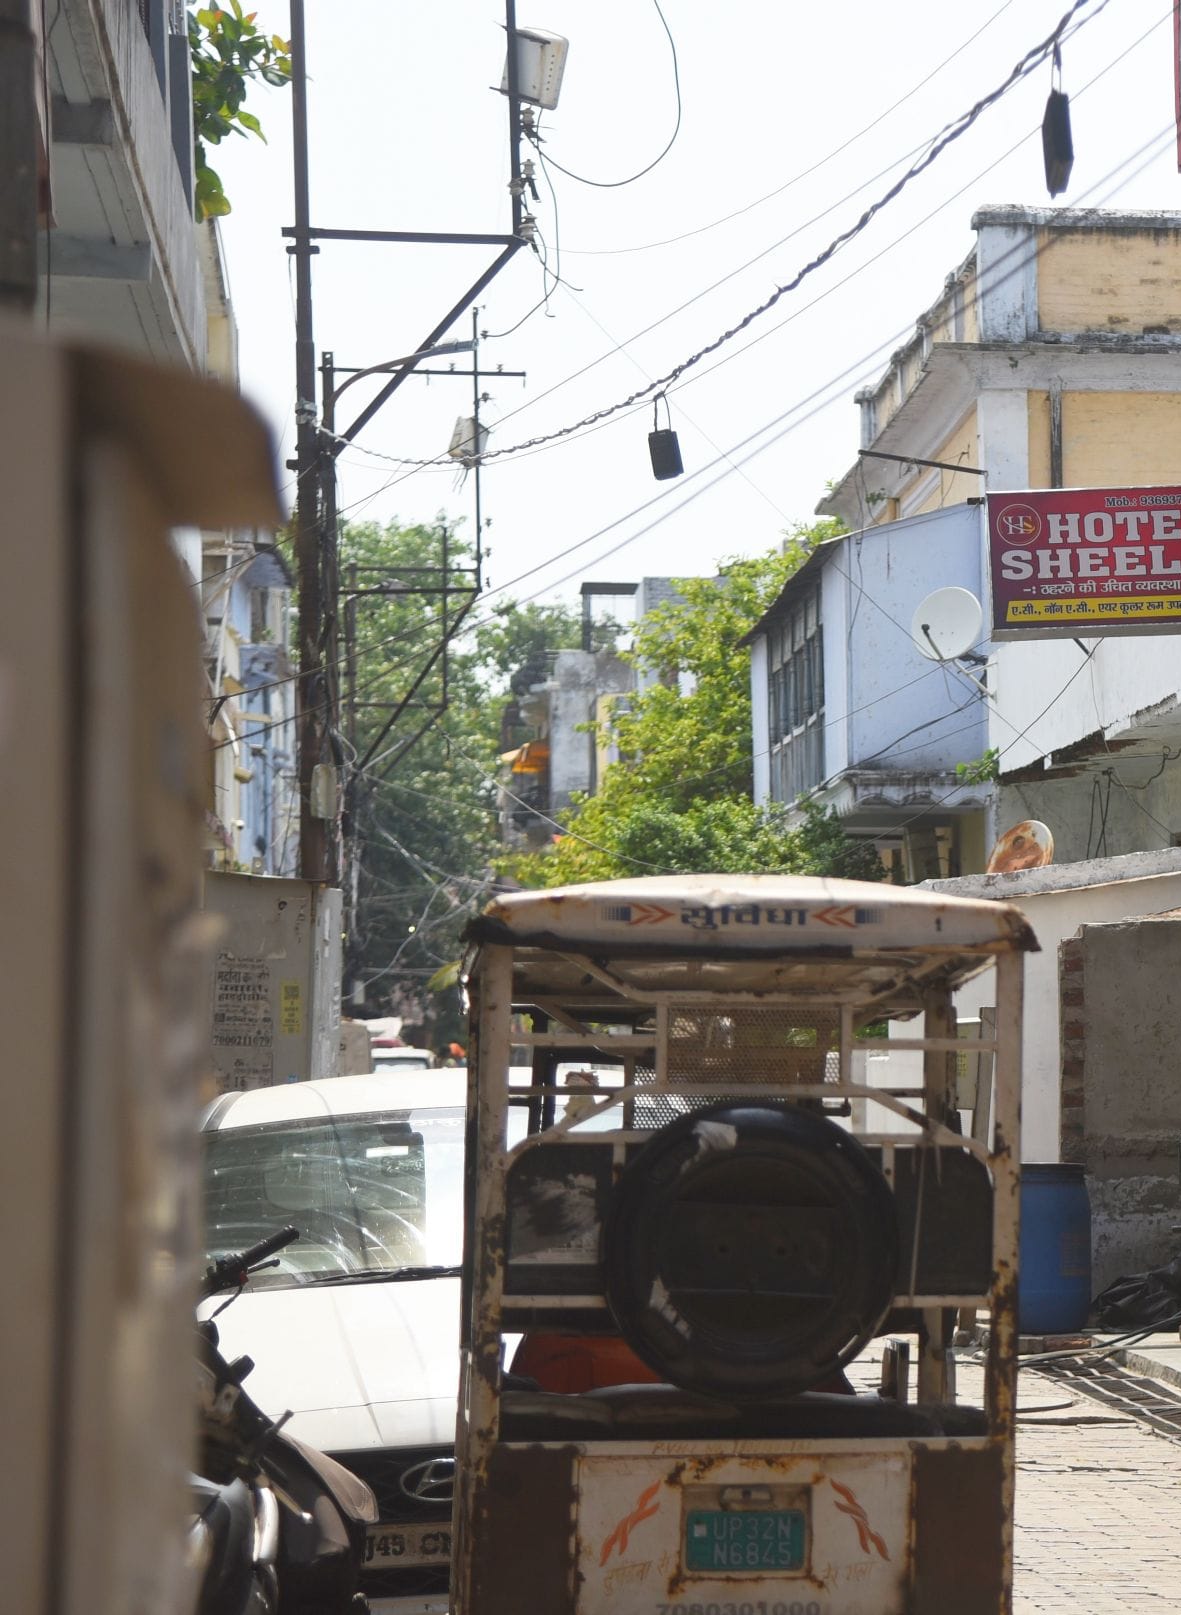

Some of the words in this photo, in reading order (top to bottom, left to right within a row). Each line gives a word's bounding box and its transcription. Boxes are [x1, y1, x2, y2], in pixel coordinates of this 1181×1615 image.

[1040, 581, 1075, 595] ठहरने
[1079, 580, 1097, 594] की
[1100, 578, 1133, 593] उचित
[1135, 579, 1181, 591] व्यवस्था
[1044, 602, 1063, 614] नॉन
[680, 904, 809, 930] सुविधा
[713, 1517, 792, 1541] UP32N
[713, 1542, 792, 1565] N6845
